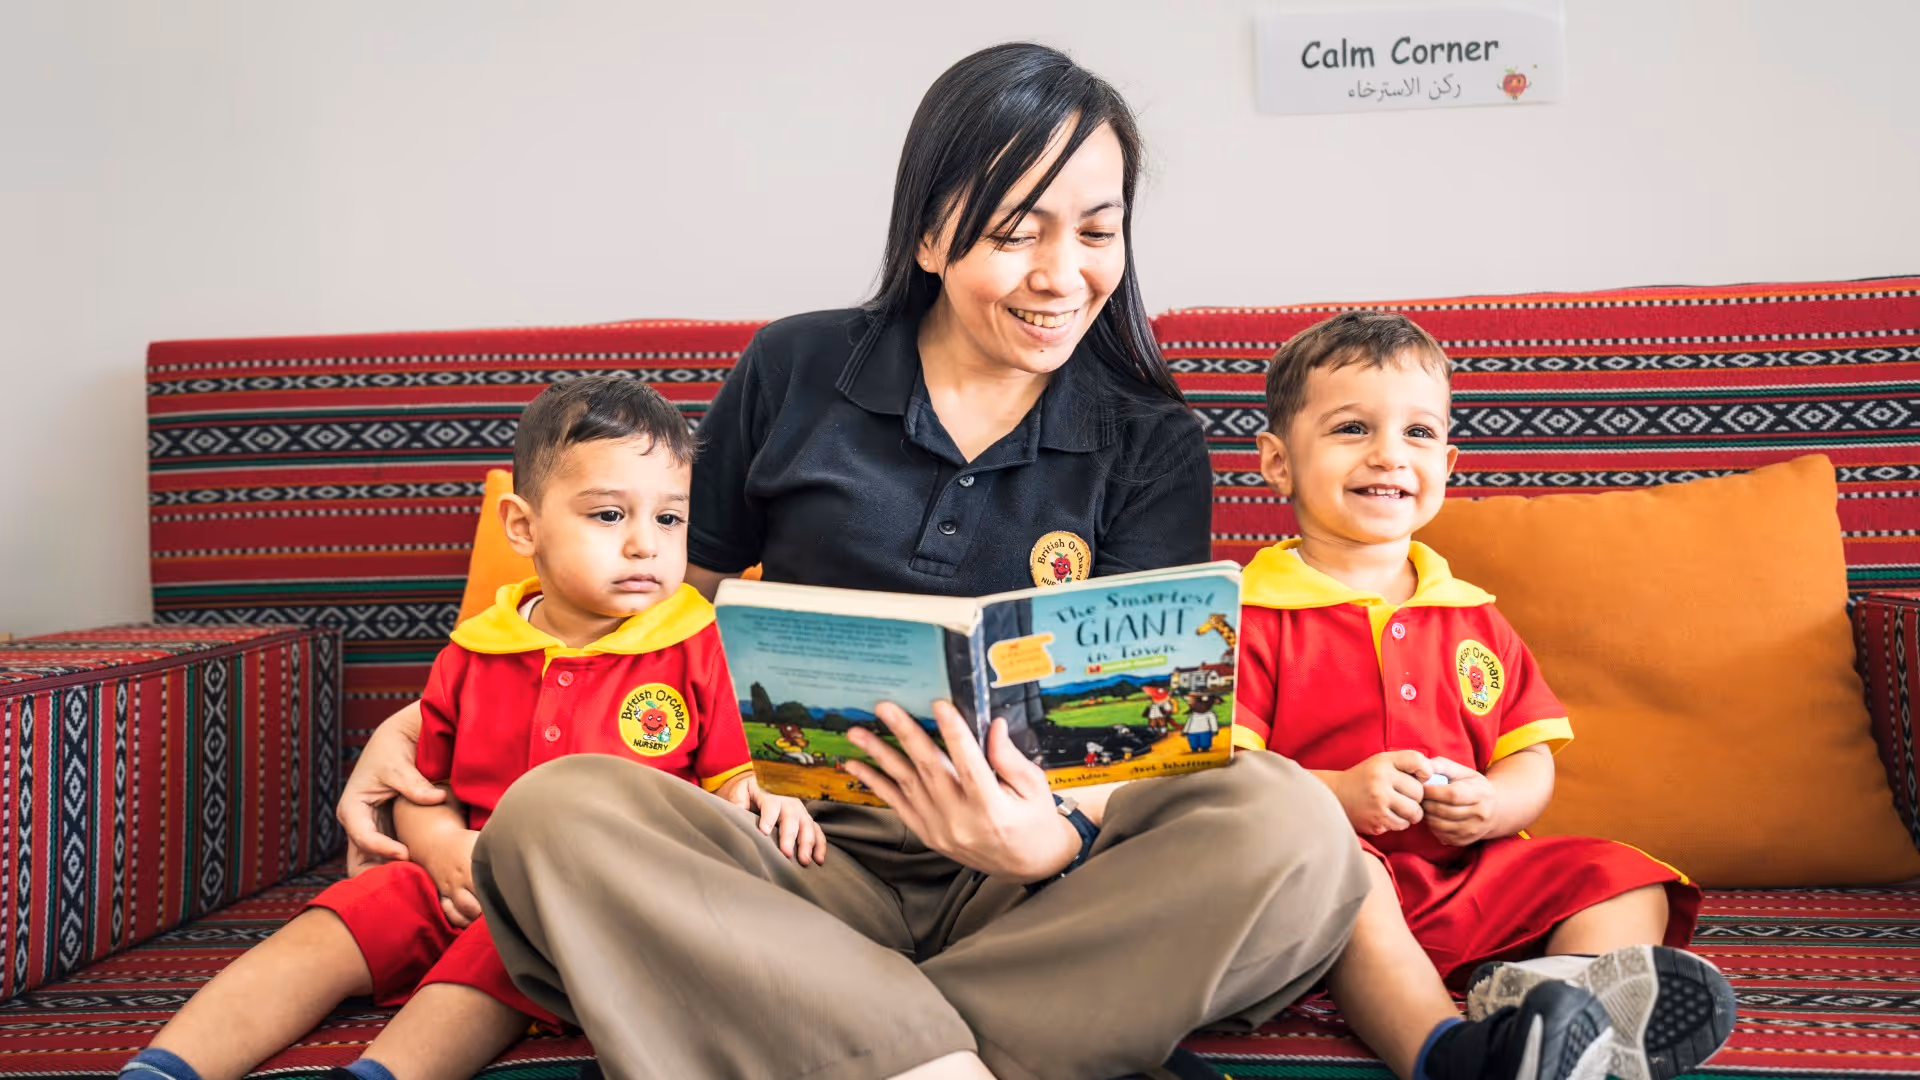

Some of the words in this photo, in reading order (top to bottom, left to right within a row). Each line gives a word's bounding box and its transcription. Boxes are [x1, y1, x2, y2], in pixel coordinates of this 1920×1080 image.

[1301, 38, 1375, 69] Calm
[1391, 36, 1499, 65] Corner
[1348, 76, 1420, 102] الاسترخاء
[1429, 73, 1462, 100] ركن
[1037, 538, 1065, 565] British
[1068, 541, 1084, 581] Orchard
[1051, 605, 1097, 624] The
[1106, 589, 1215, 608] Smartest
[1076, 607, 1194, 648] GIANT
[1087, 652, 1111, 664] in
[1117, 643, 1179, 659] Town
[1473, 647, 1500, 690] Orchard
[621, 690, 652, 721] British
[656, 689, 686, 731] Orchard
[633, 738, 669, 751] NURSERY
